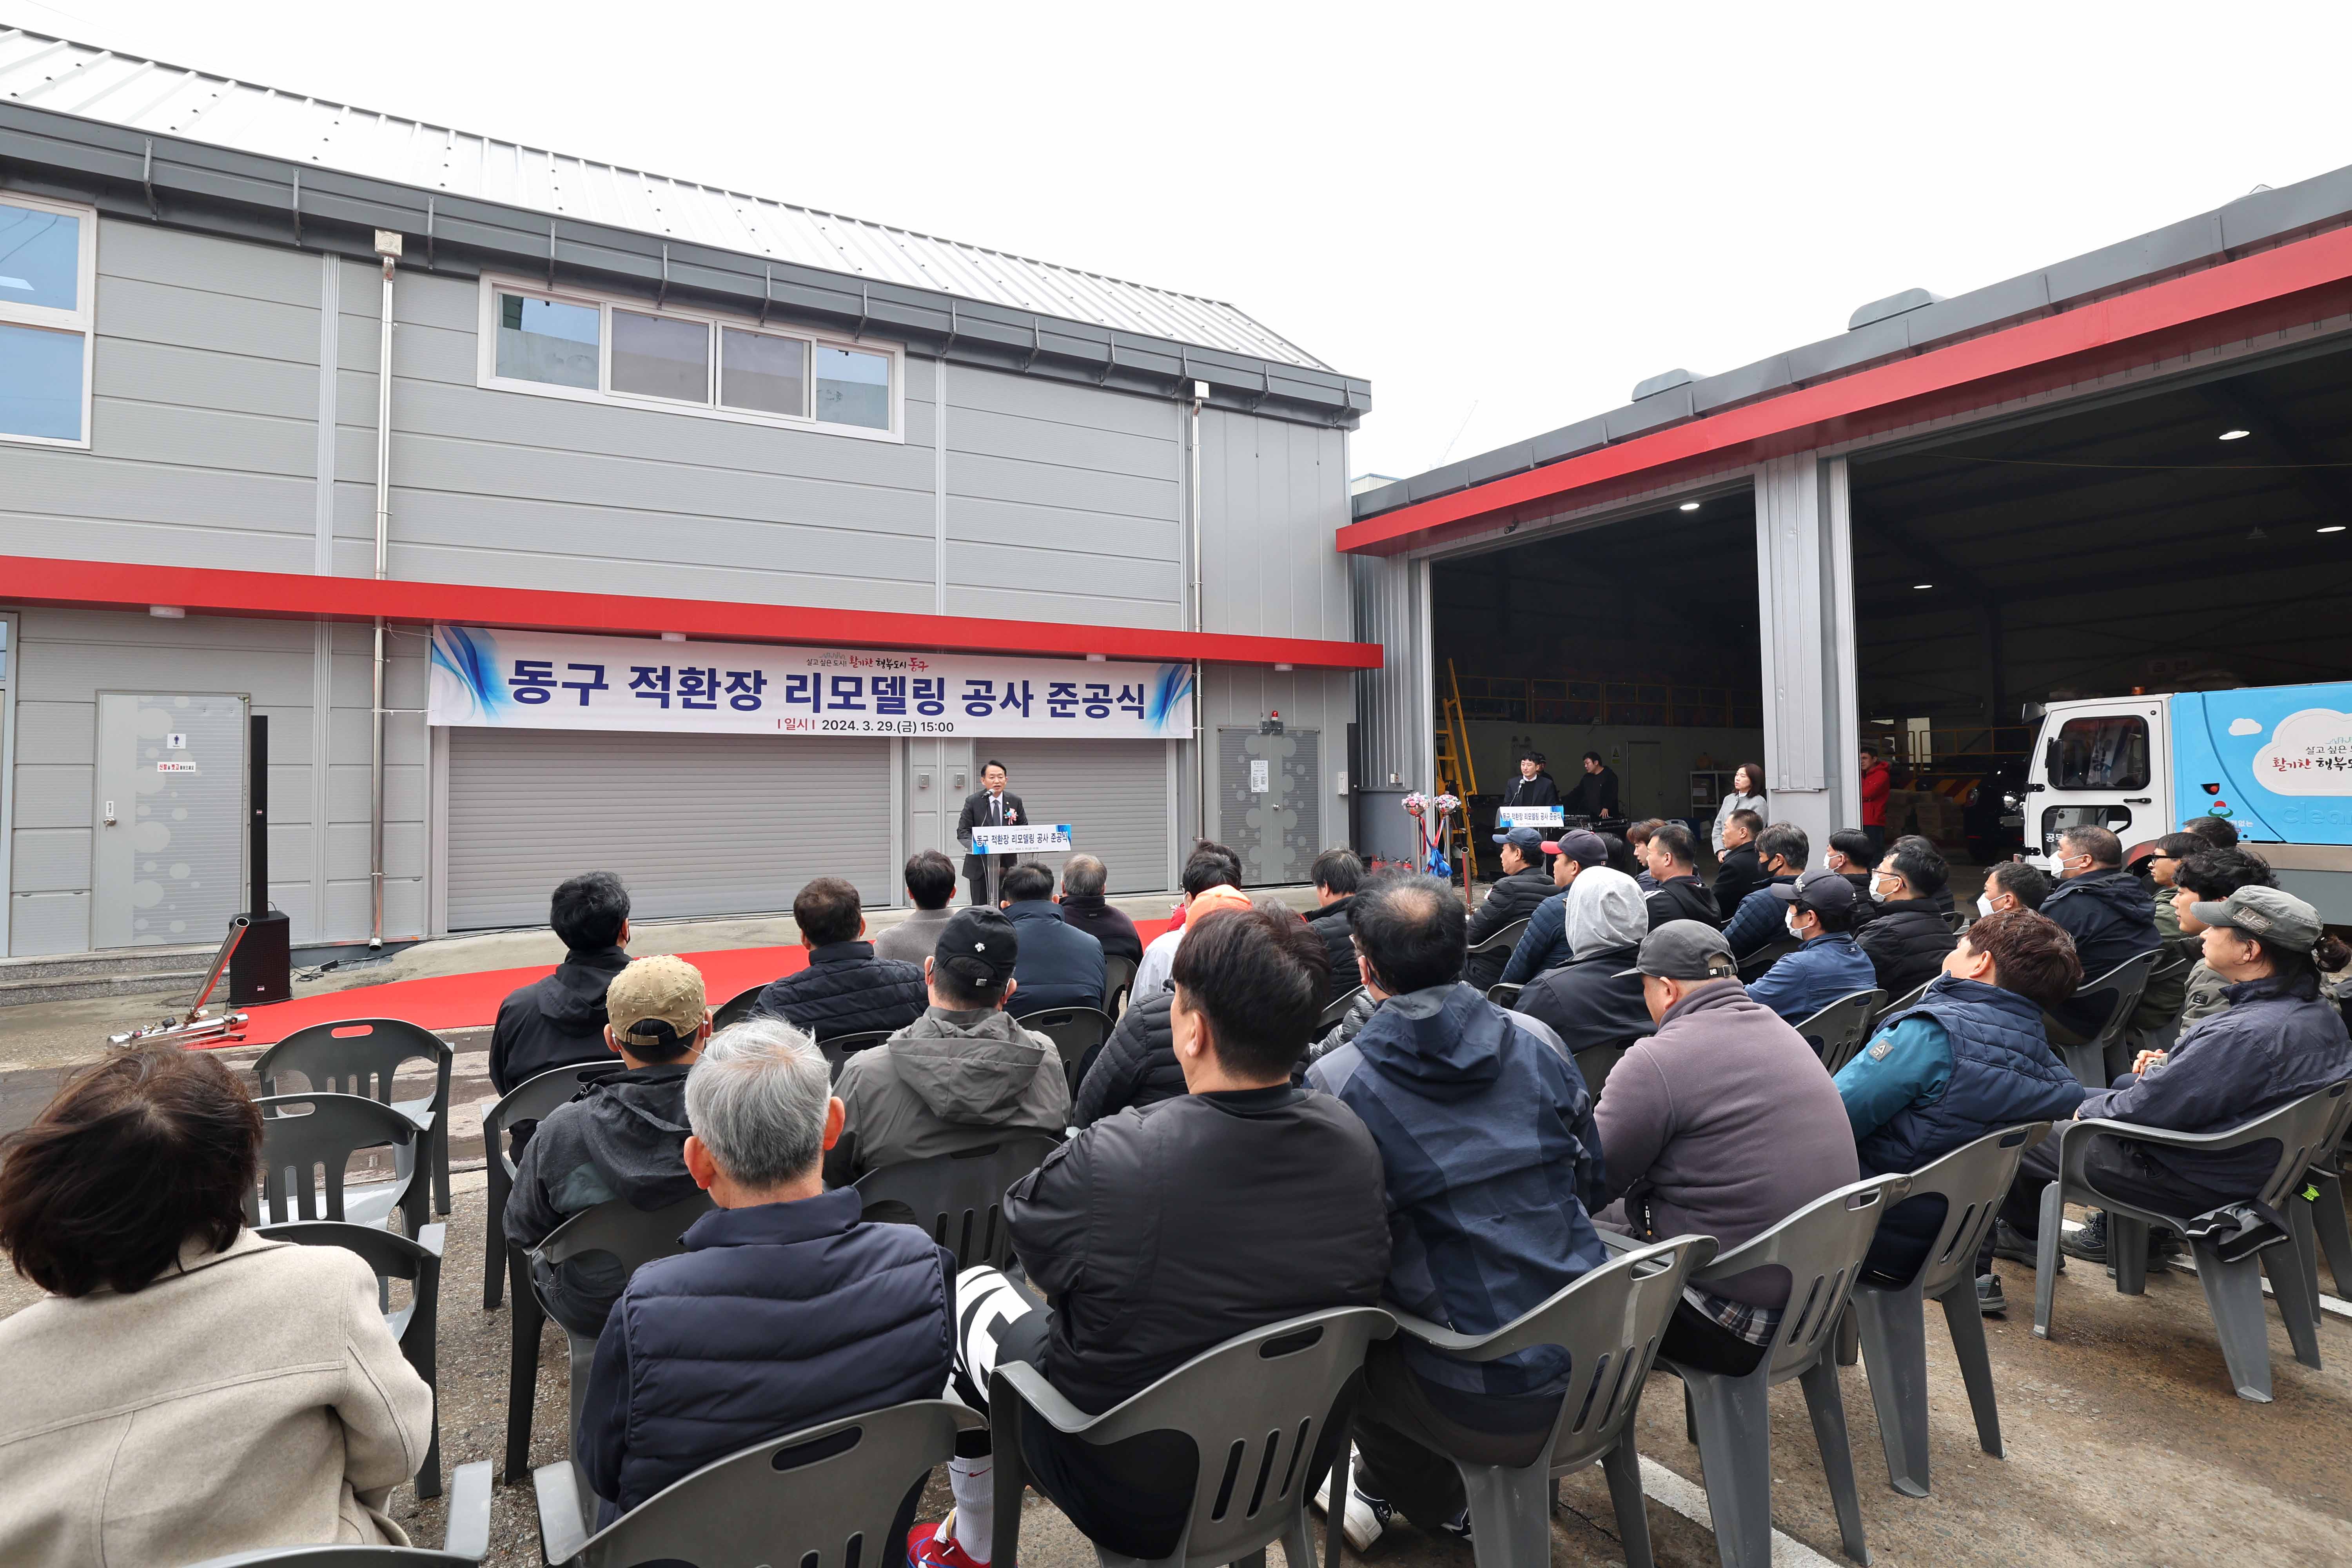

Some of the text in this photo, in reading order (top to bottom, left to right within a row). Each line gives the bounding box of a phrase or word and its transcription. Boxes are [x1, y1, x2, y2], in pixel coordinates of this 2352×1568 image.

[820, 659, 832, 667] 싶은
[833, 659, 847, 667] 도시!
[849, 655, 873, 668] 활기찬
[875, 658, 906, 670] 행복도시
[908, 657, 929, 672] 동구
[508, 660, 1145, 720] 동구 적환장 리모델링 공사 준공식
[822, 720, 859, 731] 2024.
[862, 720, 874, 731] 3.
[877, 721, 917, 734] 29.(금)
[920, 722, 954, 732] 15:00
[2306, 746, 2325, 755] 살고
[2328, 745, 2347, 754] 싶은
[2272, 756, 2352, 772] 활기찬 행복
[1503, 813, 1510, 821] 동구
[1512, 813, 1523, 821] 적환장
[1524, 813, 1539, 821] 리모델링
[977, 831, 1068, 846] 동구 적환장 리모델링 공사 준공식
